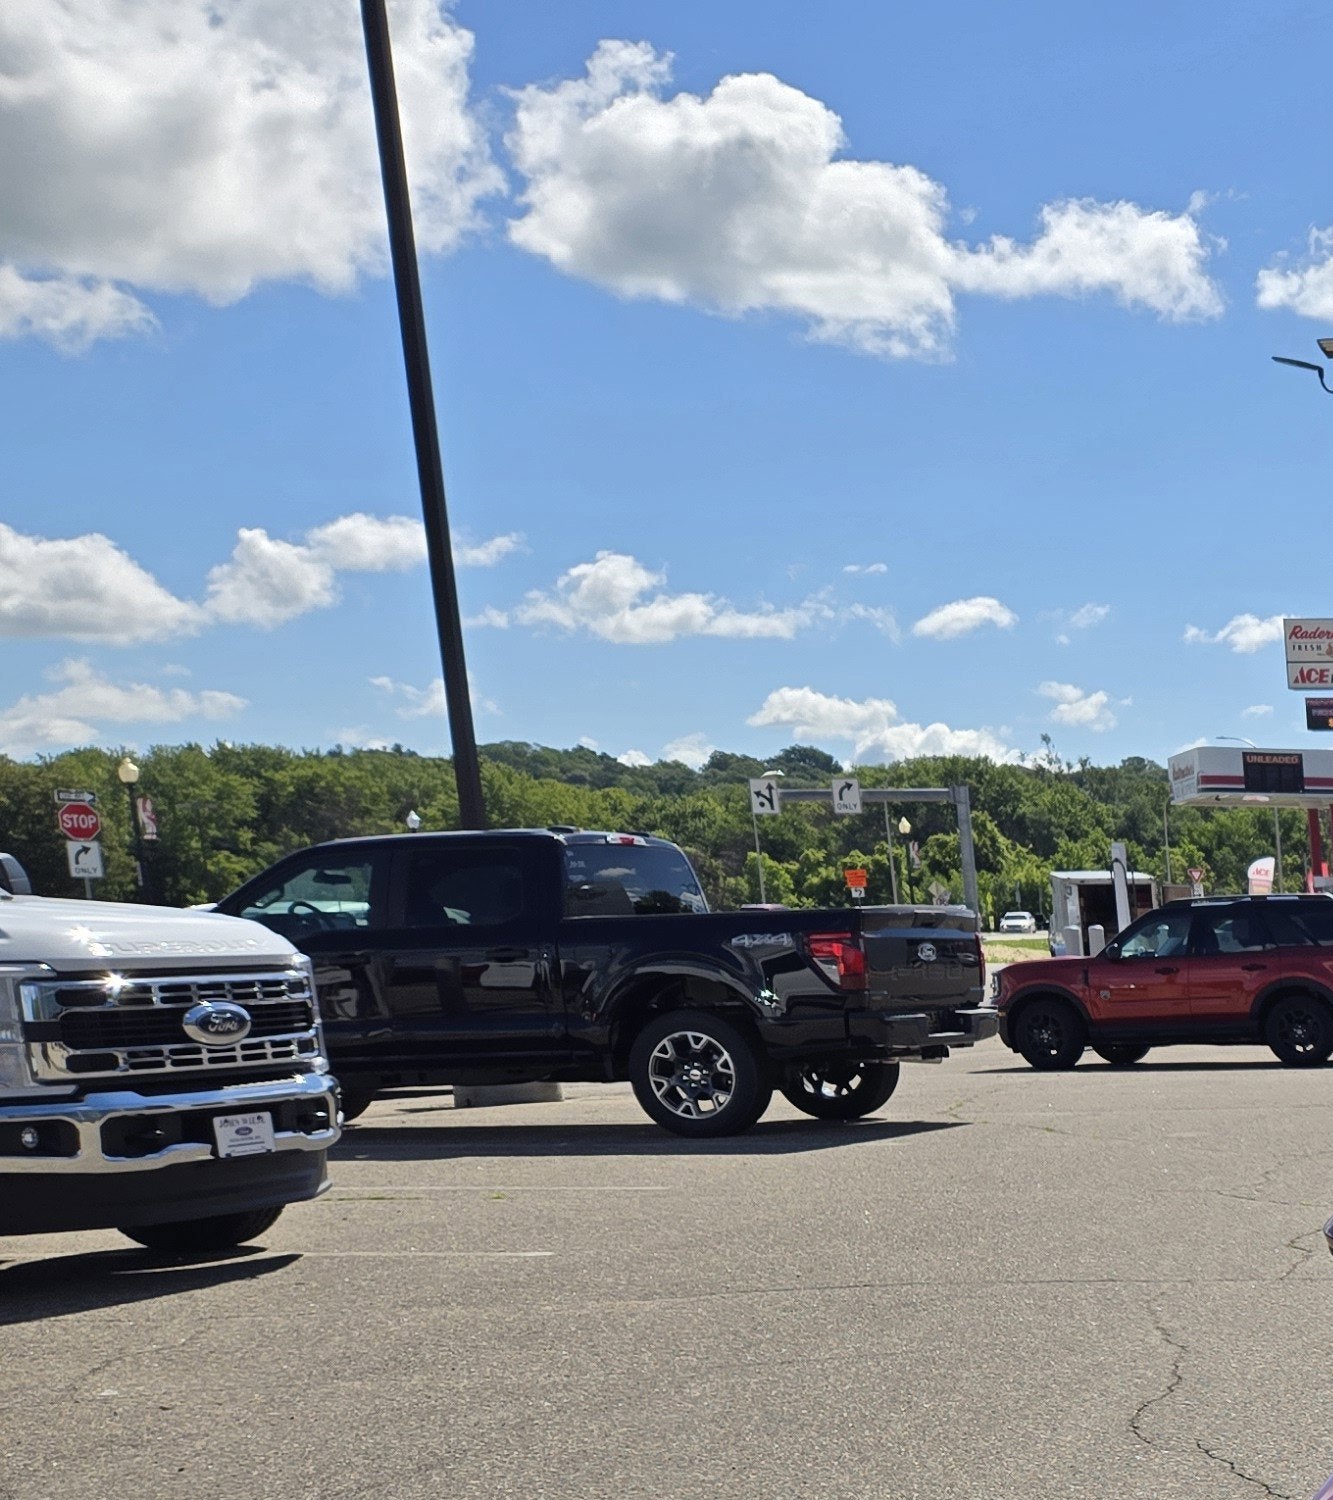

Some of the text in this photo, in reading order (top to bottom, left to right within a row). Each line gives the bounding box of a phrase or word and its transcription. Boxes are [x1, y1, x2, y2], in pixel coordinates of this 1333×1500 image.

[1293, 667, 1329, 684] ACE
[1246, 755, 1299, 764] UNLEADED
[837, 802, 857, 810] ONLY
[62, 814, 97, 829] STOP
